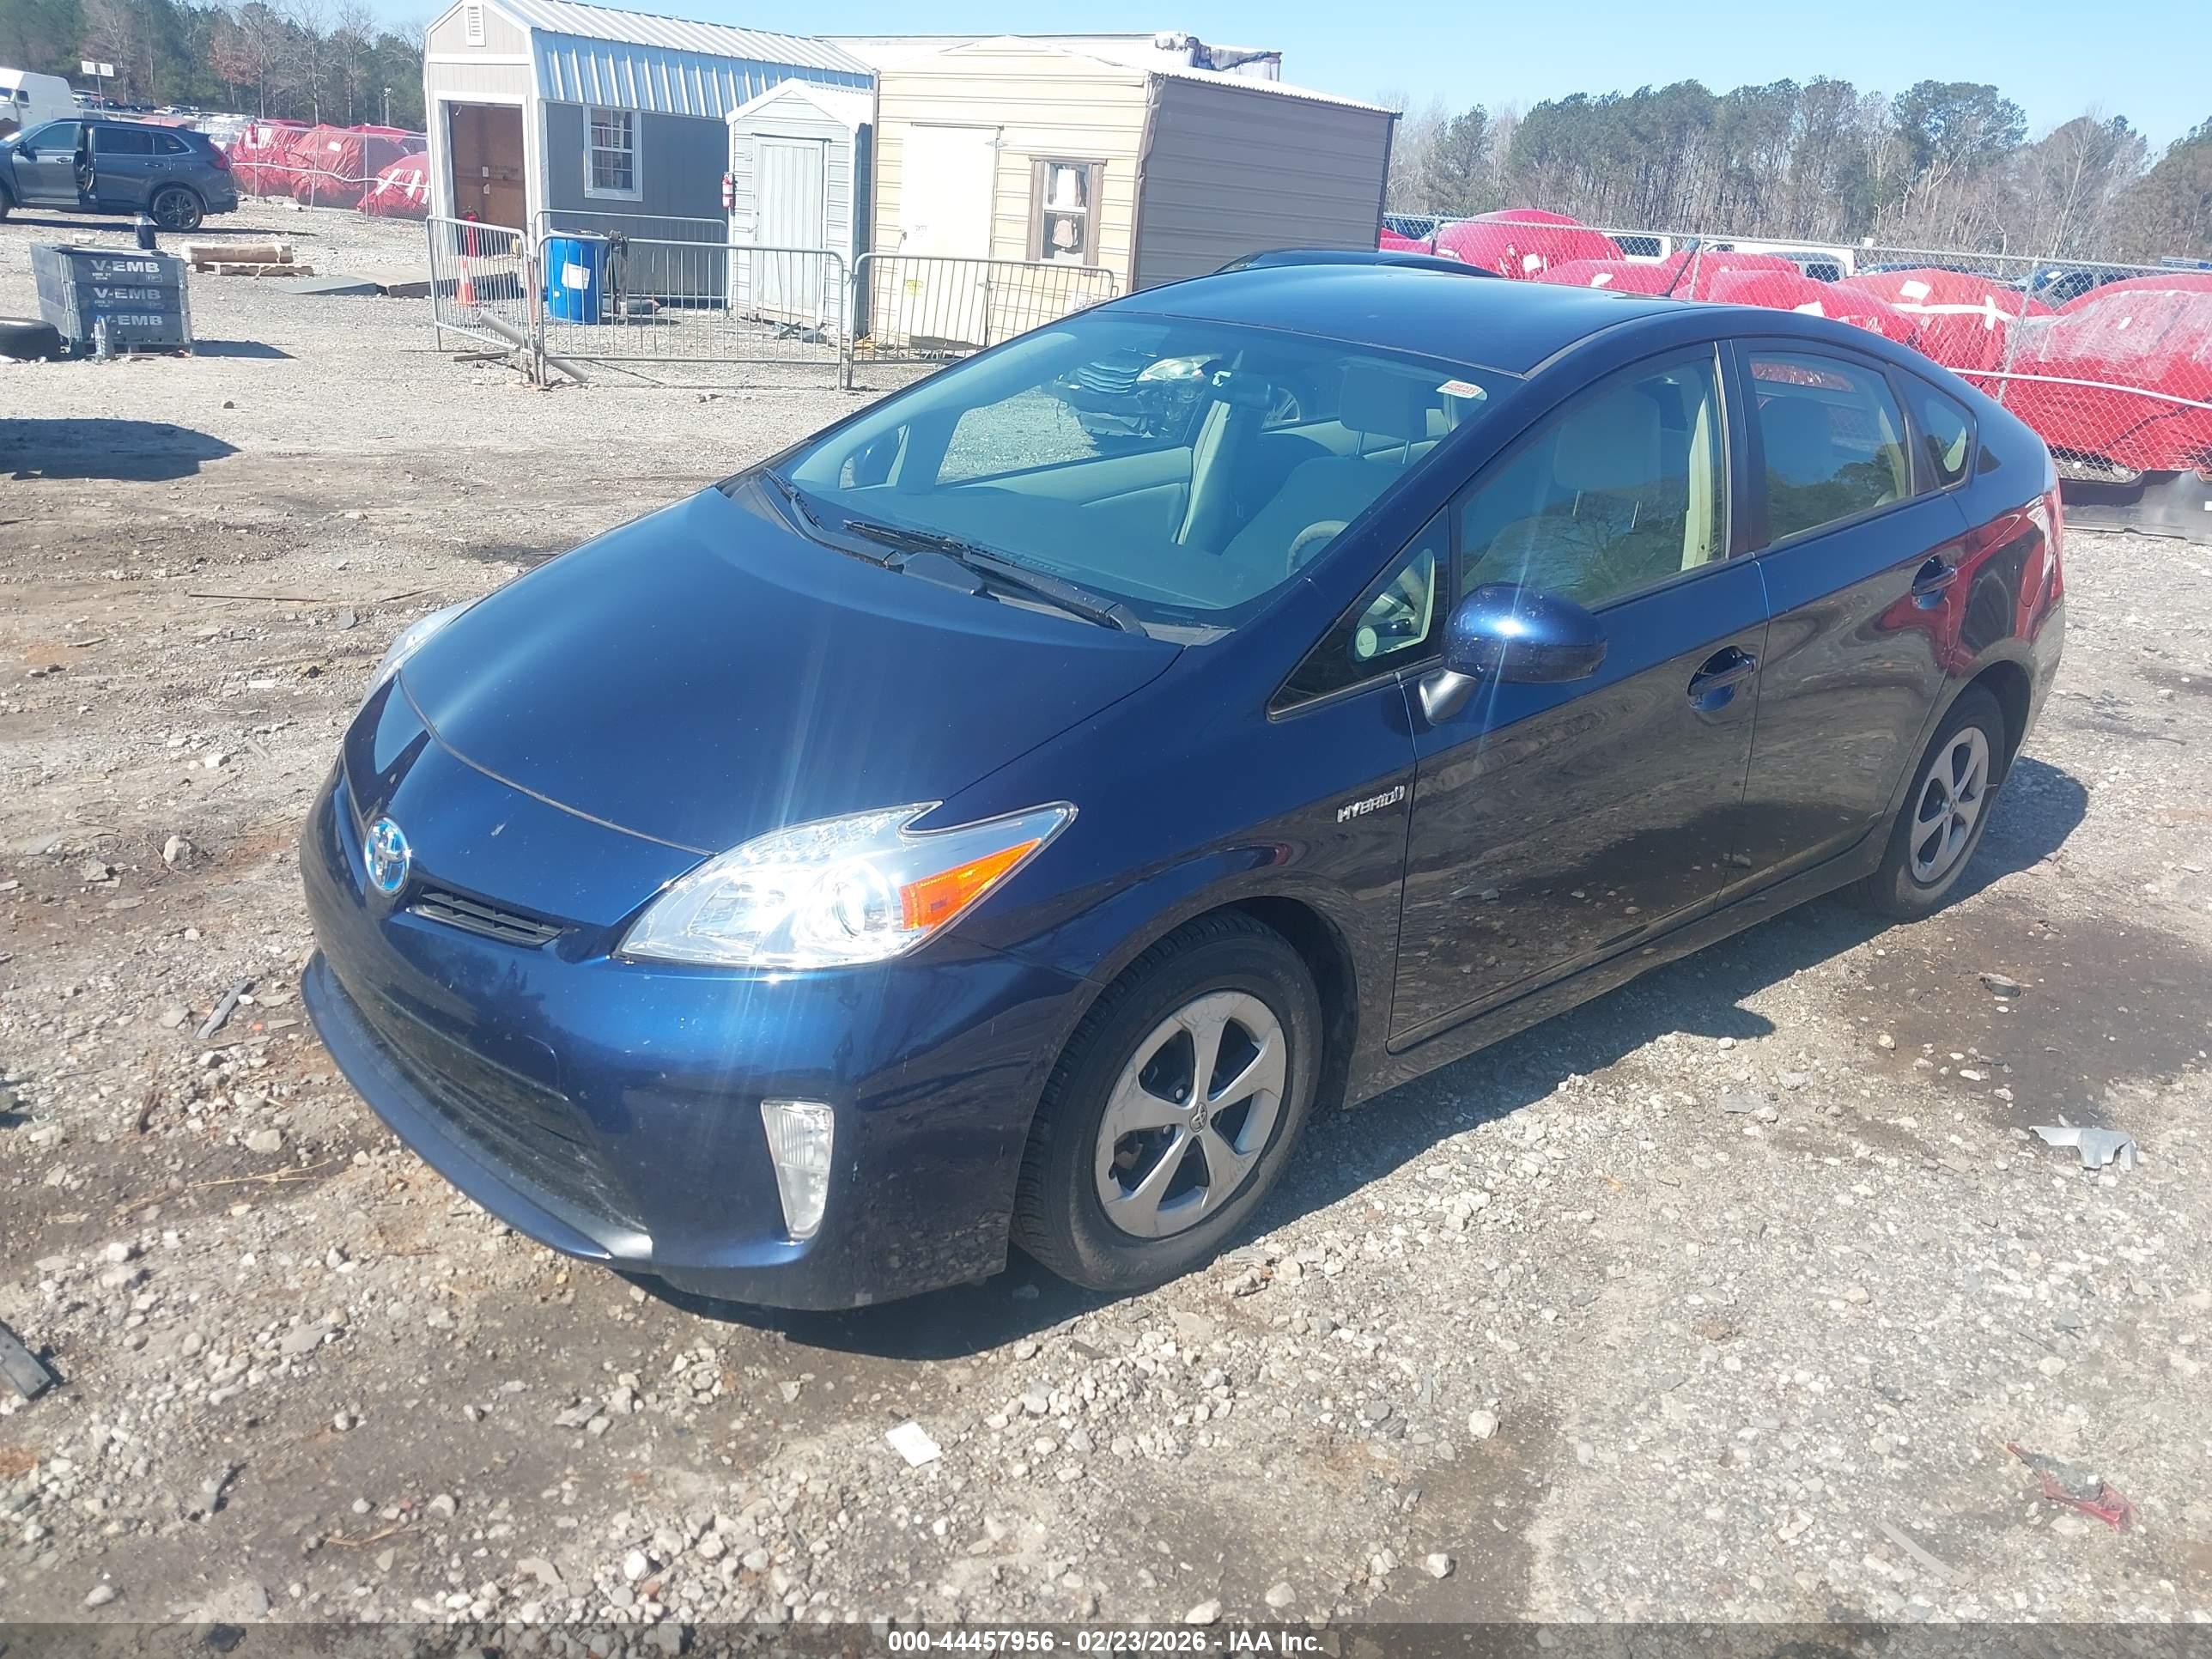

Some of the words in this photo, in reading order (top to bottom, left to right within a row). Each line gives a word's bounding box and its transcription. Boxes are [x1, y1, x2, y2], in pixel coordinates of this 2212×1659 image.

[90, 260, 160, 273] V-EMB
[93, 287, 161, 299] V-EMB
[1337, 787, 1398, 823] HYBRID
